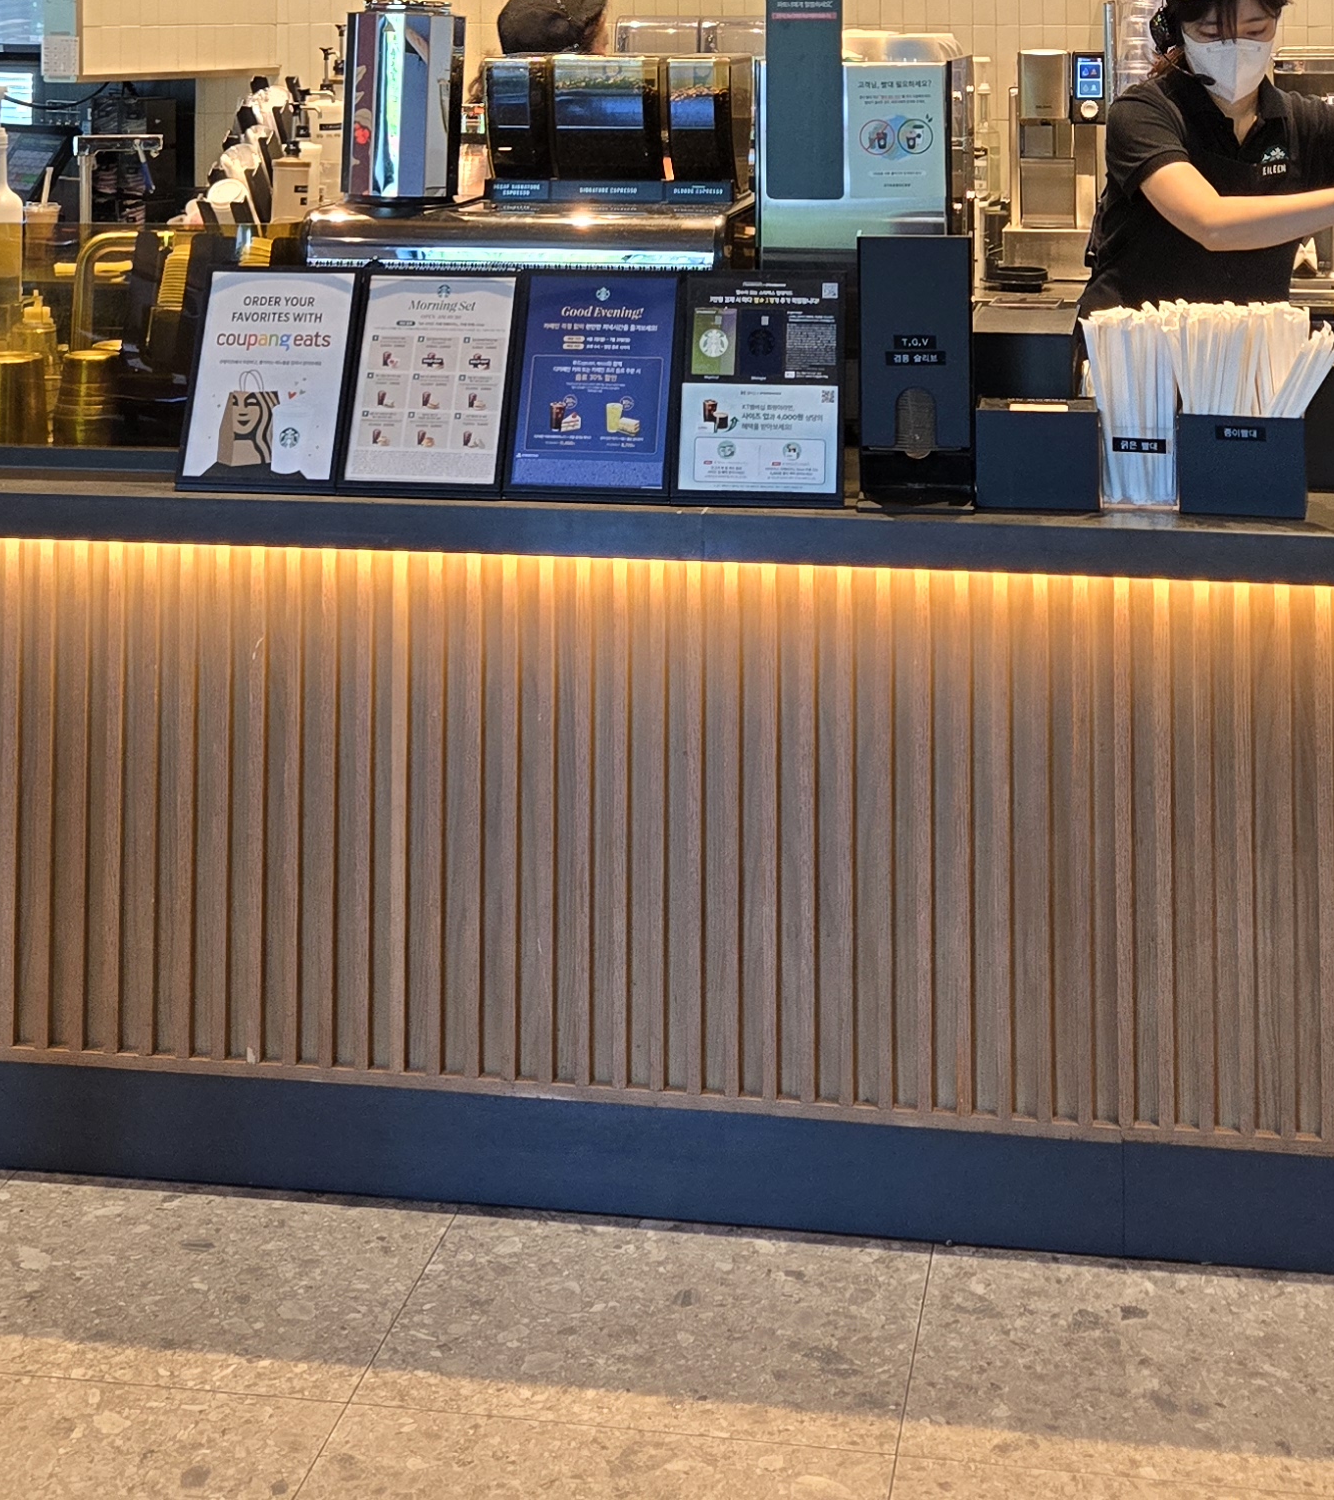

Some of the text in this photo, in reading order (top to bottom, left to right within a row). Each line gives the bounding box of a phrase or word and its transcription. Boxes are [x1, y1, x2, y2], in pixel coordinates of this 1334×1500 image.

[858, 81, 879, 89] 고객님,
[896, 80, 932, 88] 필요하세요?
[243, 296, 315, 307] ORDER YOUR
[408, 300, 476, 313] Morning Set
[231, 311, 323, 323] FAVORITES WITH
[561, 306, 644, 320] Good Evening!
[216, 331, 331, 352] coupang eats
[913, 354, 938, 362] 슬리브
[1224, 428, 1257, 438] 종이빨대
[1141, 441, 1158, 450] 빨대
